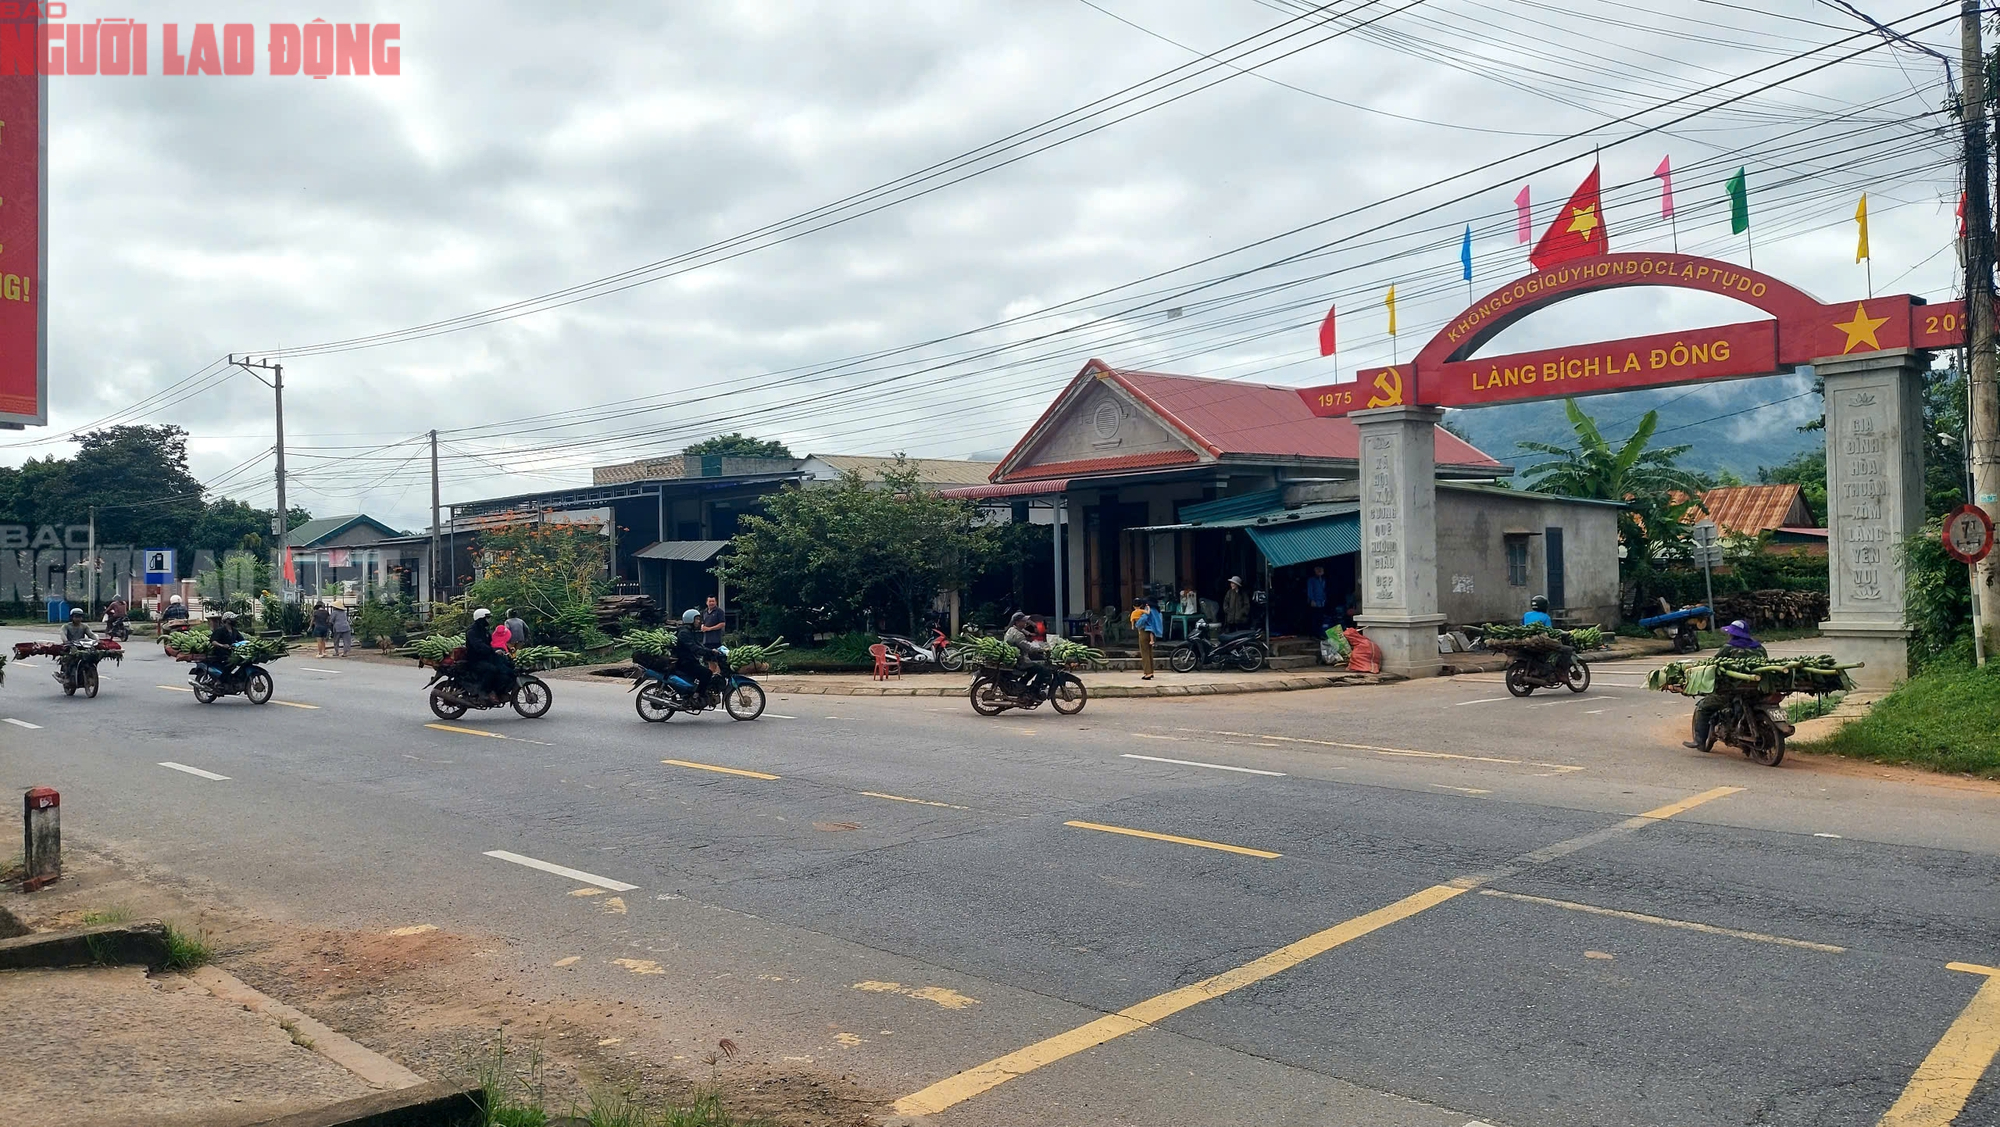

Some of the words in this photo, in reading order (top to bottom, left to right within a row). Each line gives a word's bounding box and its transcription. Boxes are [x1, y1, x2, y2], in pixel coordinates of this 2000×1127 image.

[1472, 364, 1537, 390] LÀNG
[1543, 356, 1600, 382] BÍCH
[1607, 352, 1641, 375] LA
[1650, 341, 1730, 369] ĐÔNG
[1318, 391, 1352, 407] 1975
[1853, 417, 1875, 432] GIA
[1846, 437, 1880, 455] ĐÌNH
[1843, 479, 1887, 499] THUẬN
[1852, 501, 1881, 520] XÓM
[1848, 525, 1884, 543] LÀNG
[1852, 545, 1881, 564] YÊN
[1853, 569, 1878, 585] VUI
